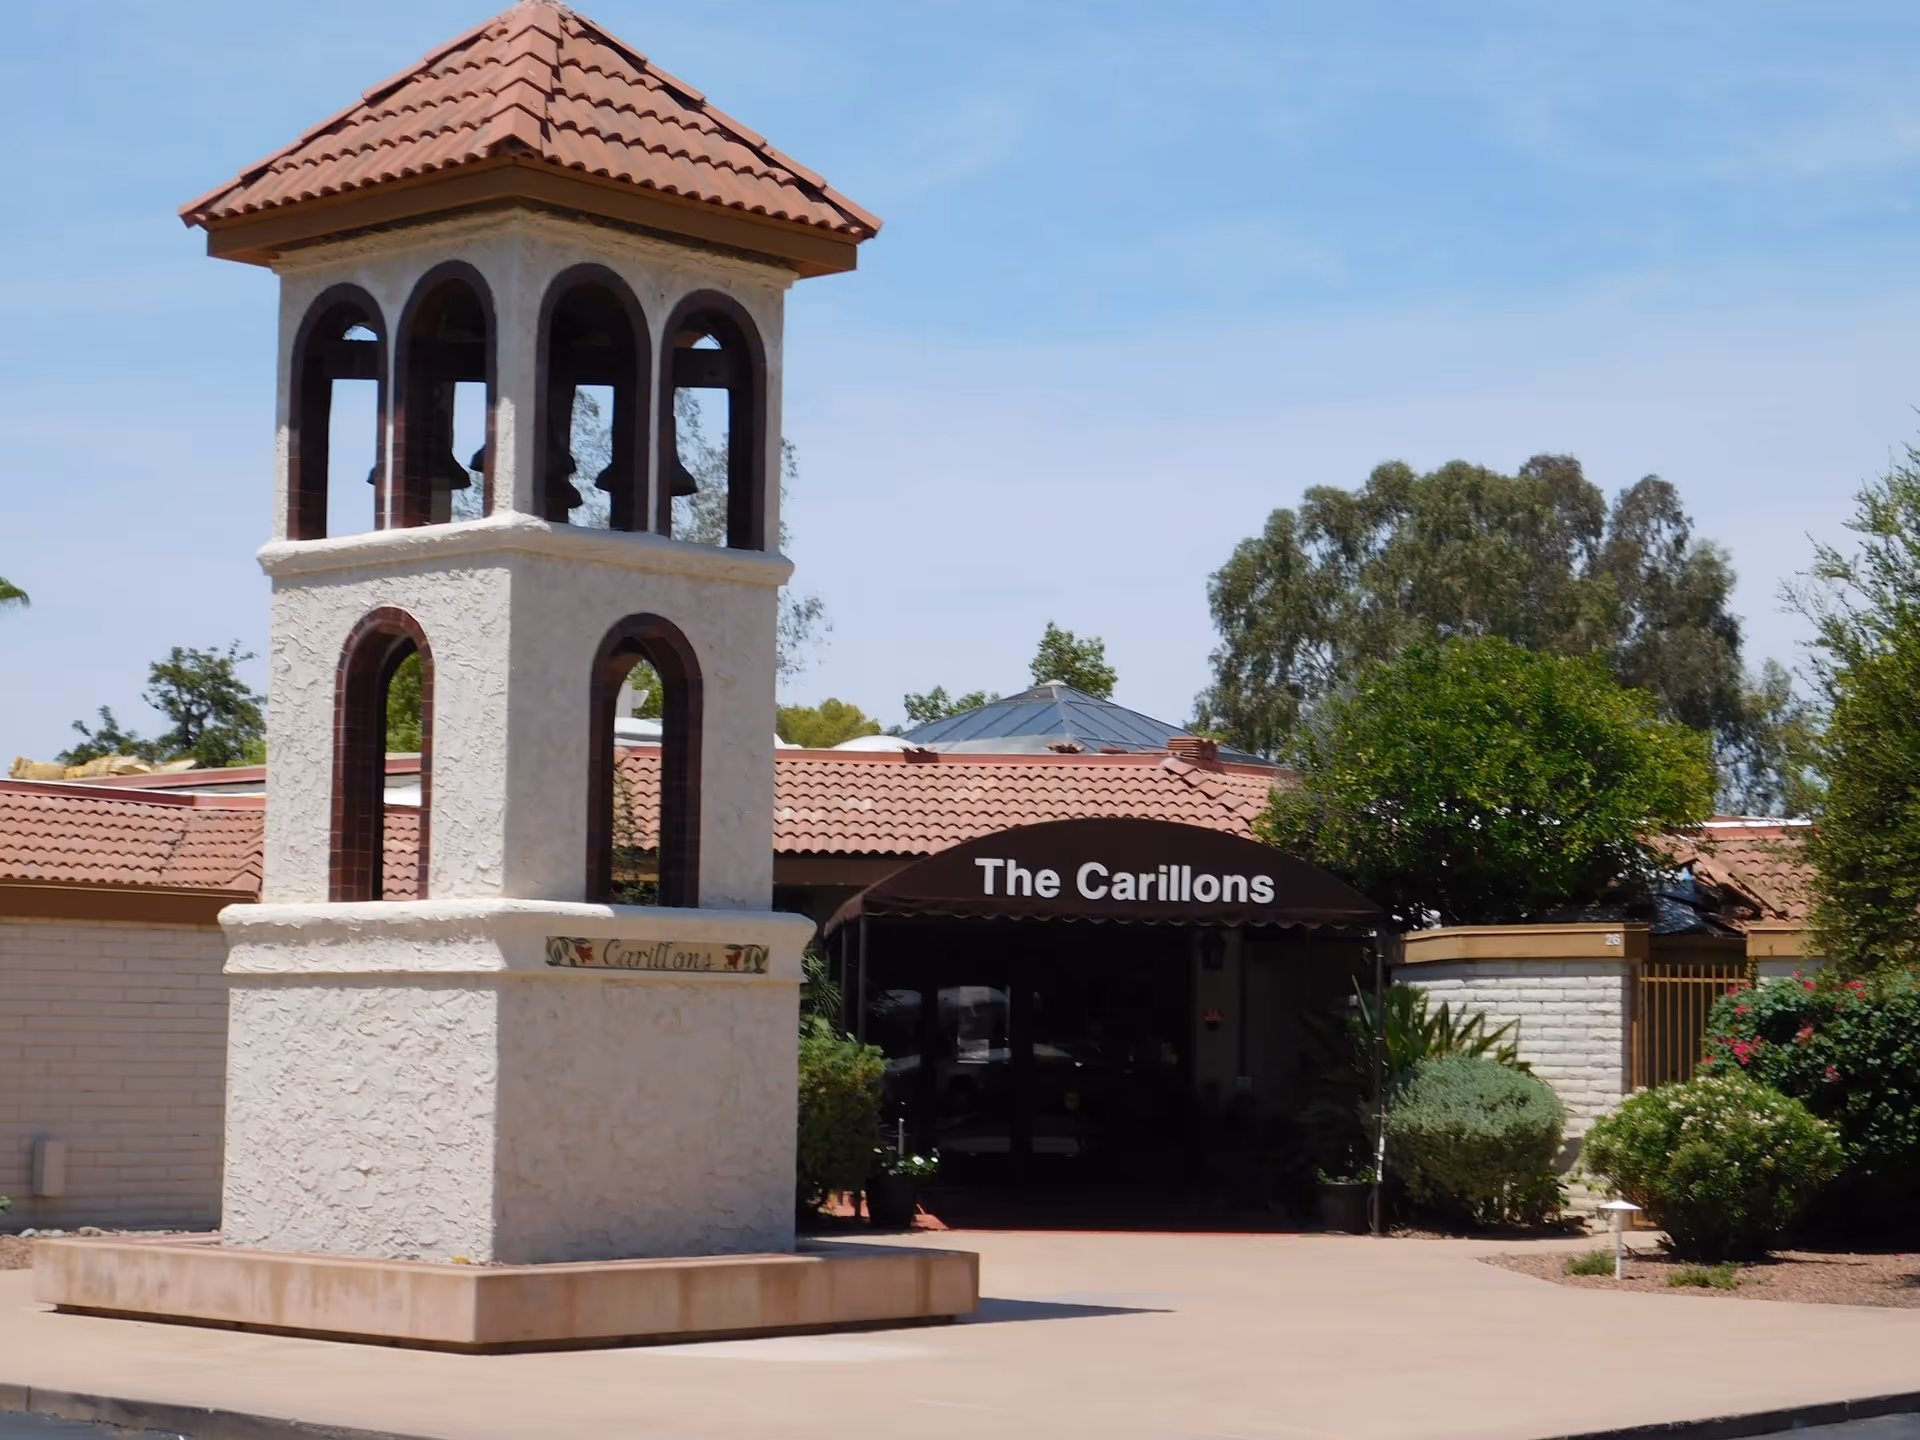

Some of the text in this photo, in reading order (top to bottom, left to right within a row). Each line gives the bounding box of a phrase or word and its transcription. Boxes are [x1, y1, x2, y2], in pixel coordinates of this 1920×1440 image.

[974, 858, 1275, 903] The Carillons
[603, 938, 715, 970] Carillons
